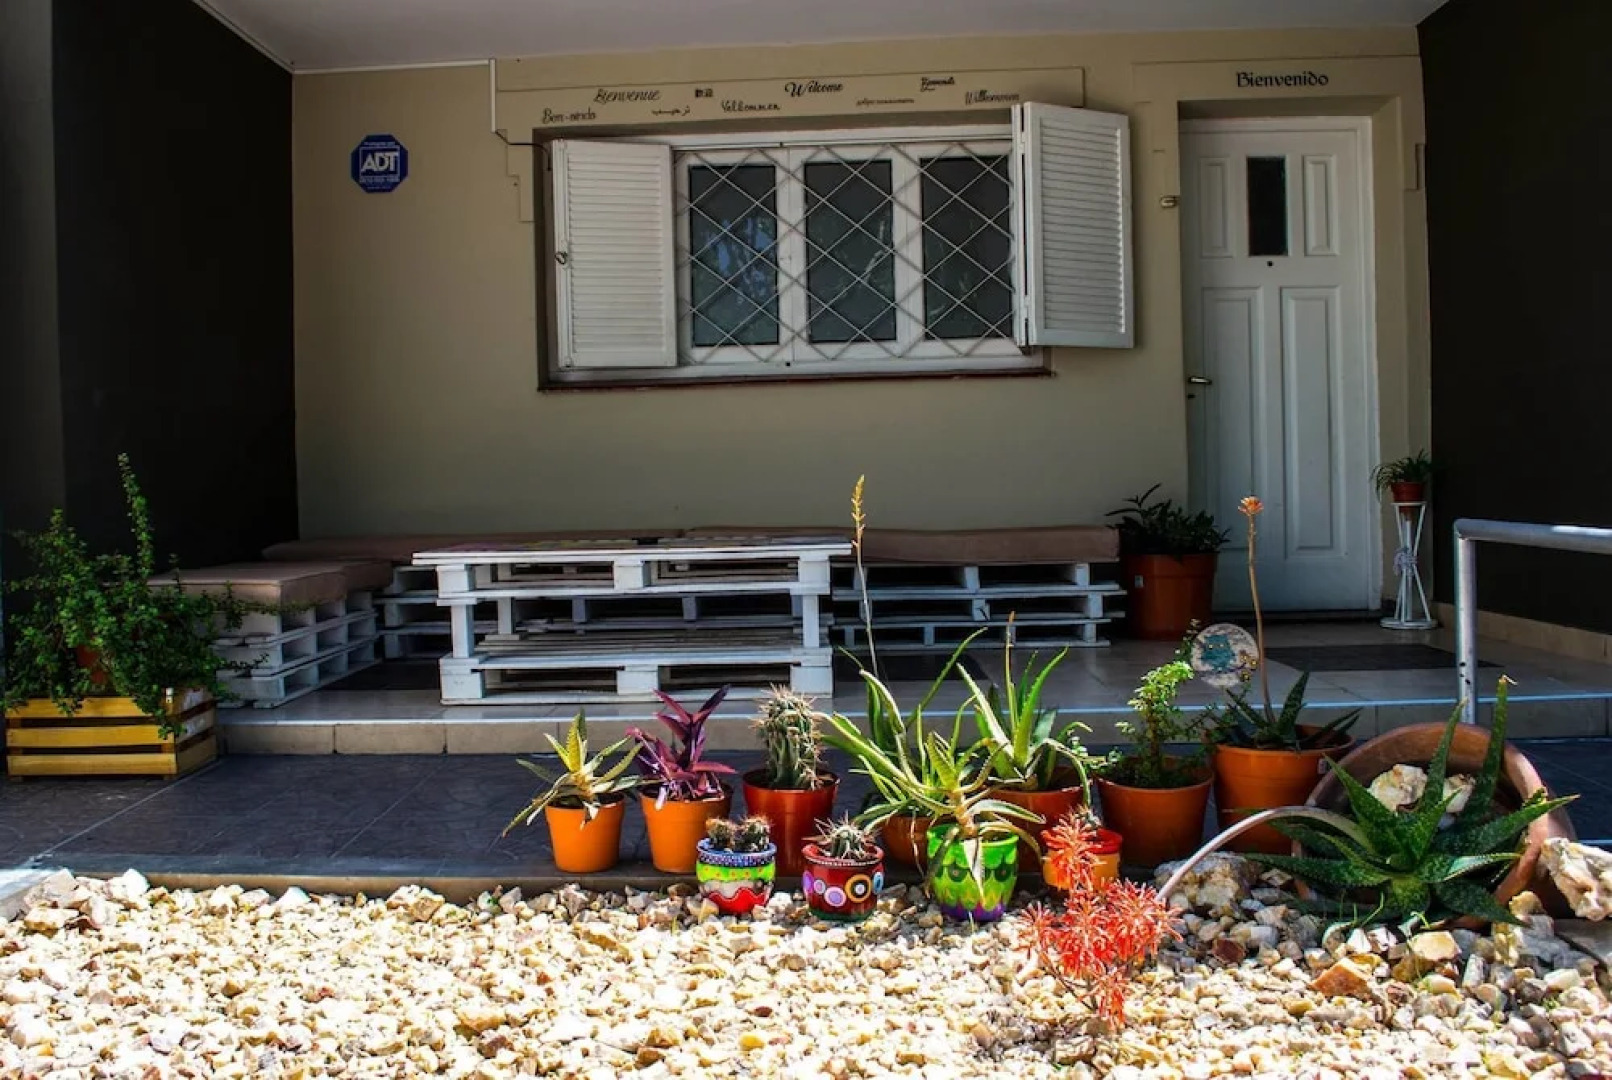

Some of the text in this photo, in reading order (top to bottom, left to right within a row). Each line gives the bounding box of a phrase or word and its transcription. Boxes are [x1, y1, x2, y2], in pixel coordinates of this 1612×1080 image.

[1237, 71, 1329, 87] Bienvenido
[784, 80, 843, 98] Welcome
[360, 151, 399, 172] ADT
